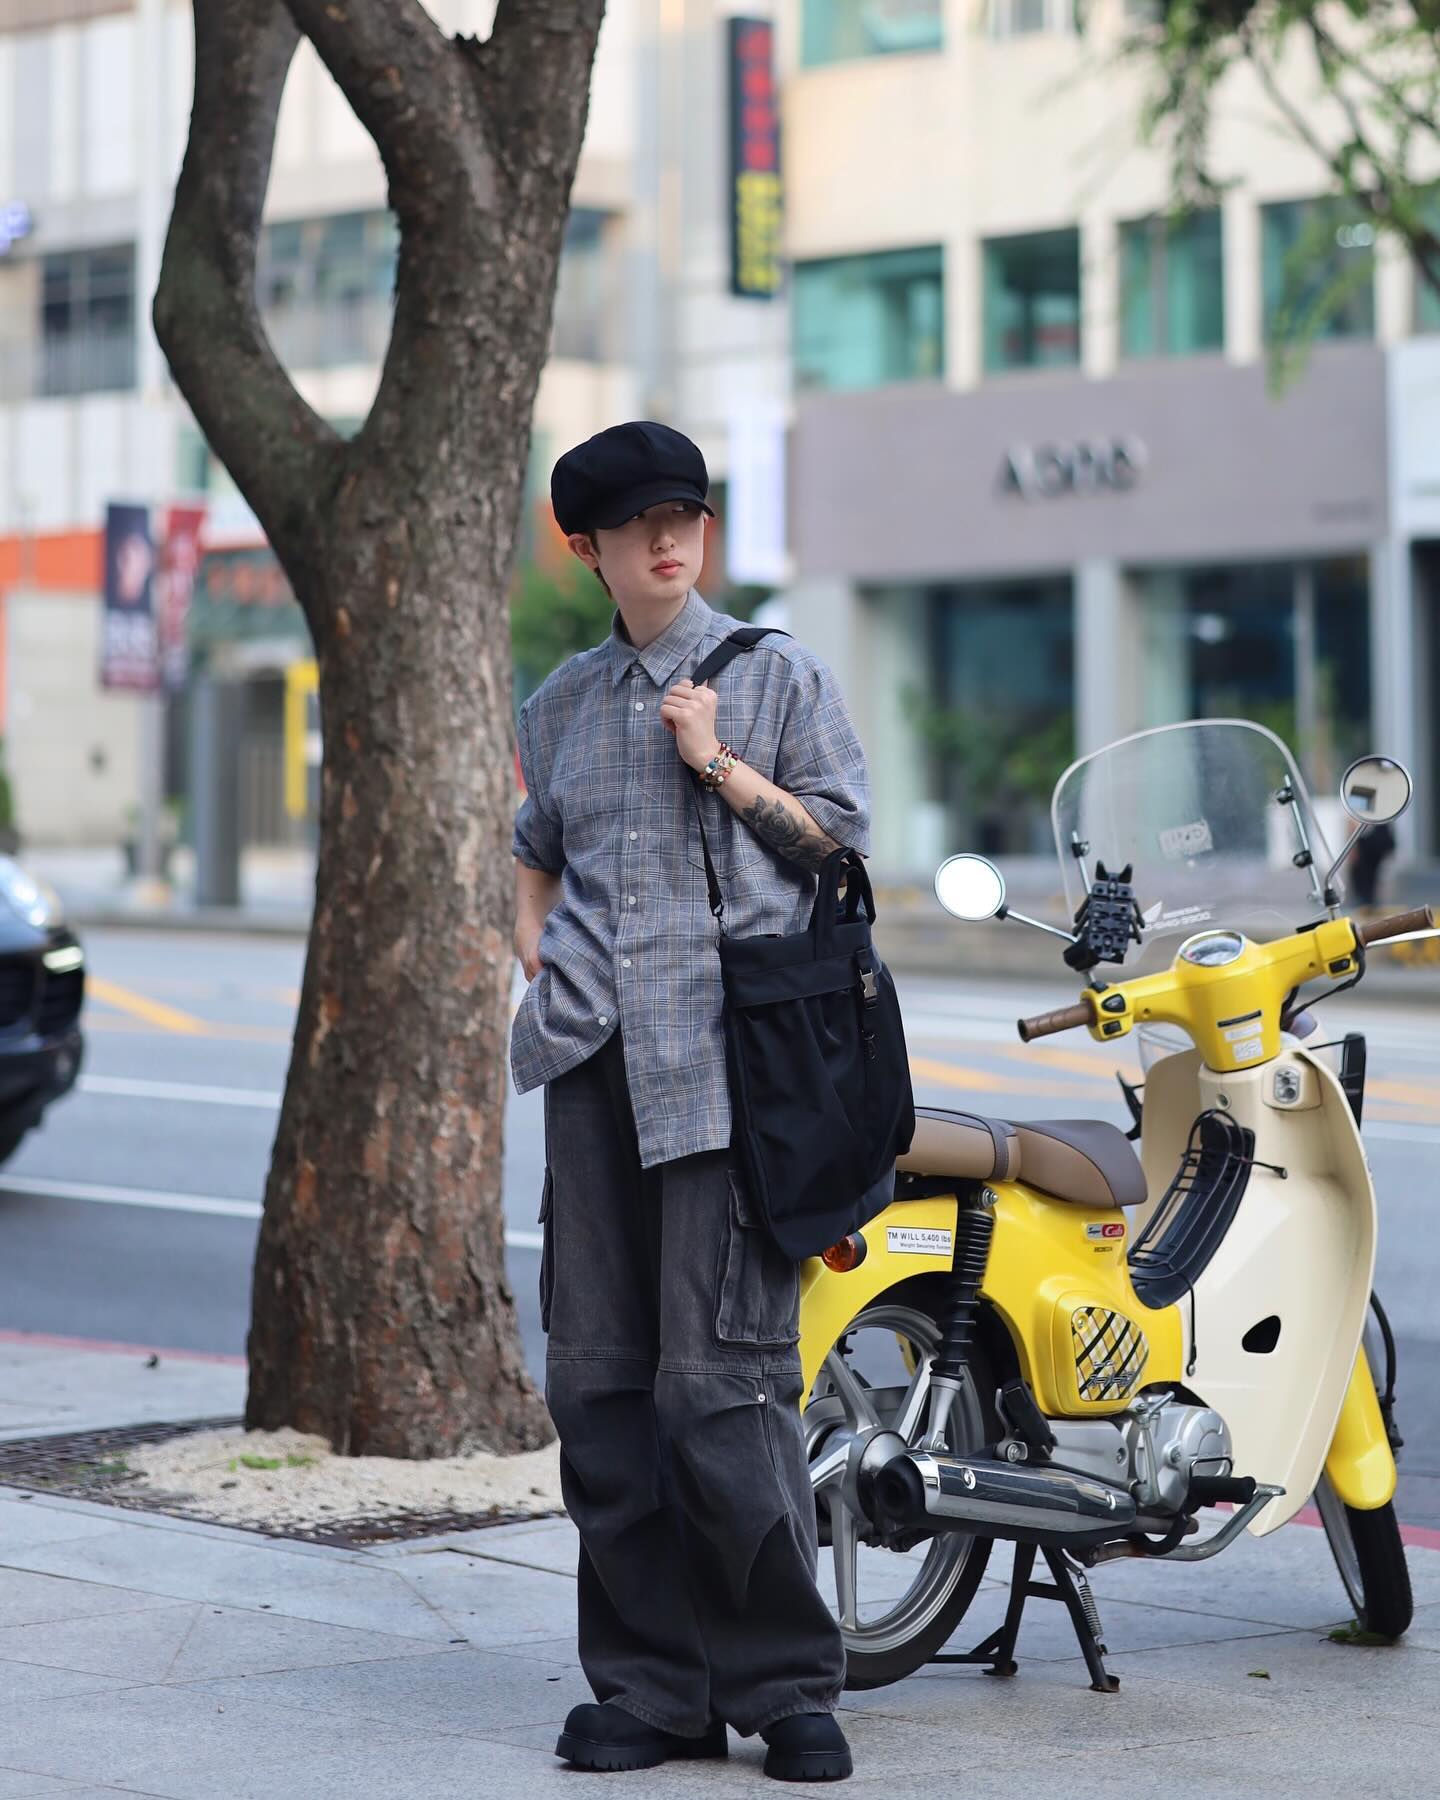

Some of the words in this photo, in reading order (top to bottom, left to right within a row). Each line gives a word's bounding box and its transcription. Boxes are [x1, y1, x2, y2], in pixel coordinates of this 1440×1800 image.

[888, 1231, 898, 1240] TM
[900, 1232, 920, 1241] WILL
[941, 1234, 951, 1243] lbs
